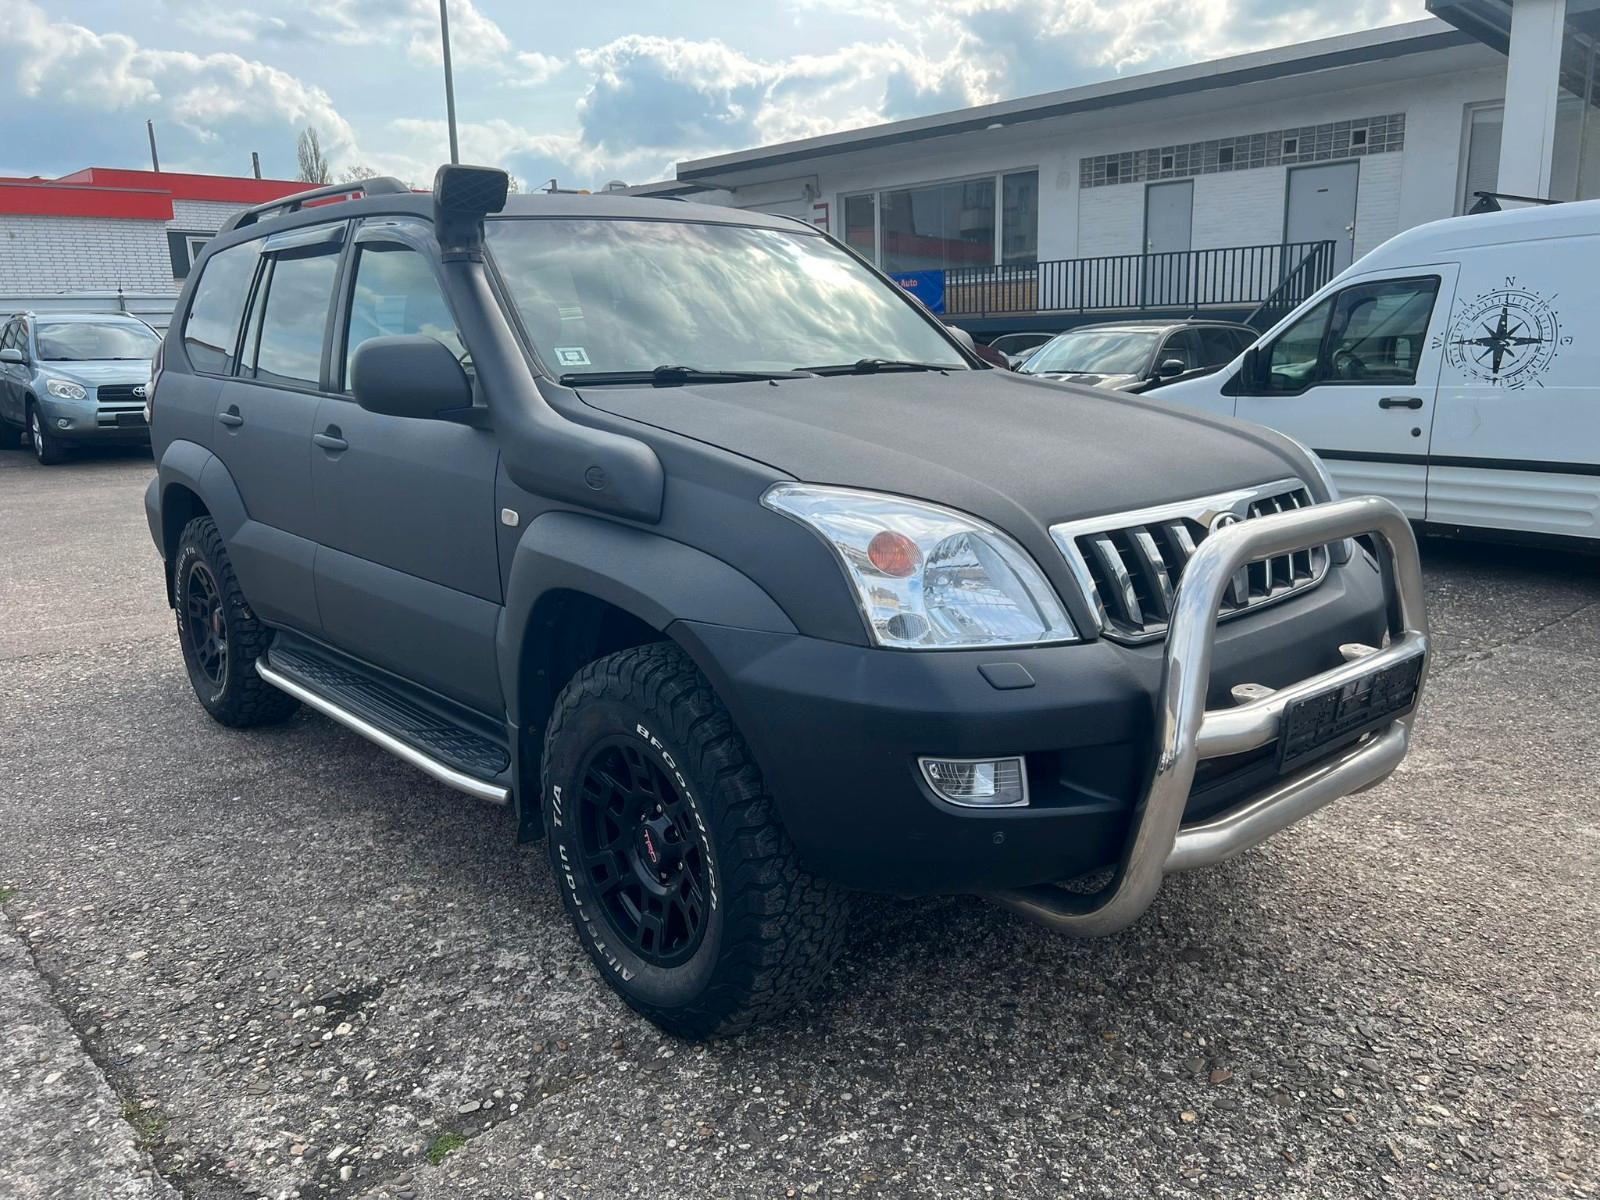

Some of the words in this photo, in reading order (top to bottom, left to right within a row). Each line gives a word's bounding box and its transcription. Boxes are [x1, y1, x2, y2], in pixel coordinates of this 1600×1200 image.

[901, 278, 918, 288] Auto
[1504, 276, 1516, 287] N
[644, 829, 657, 863] TRD
